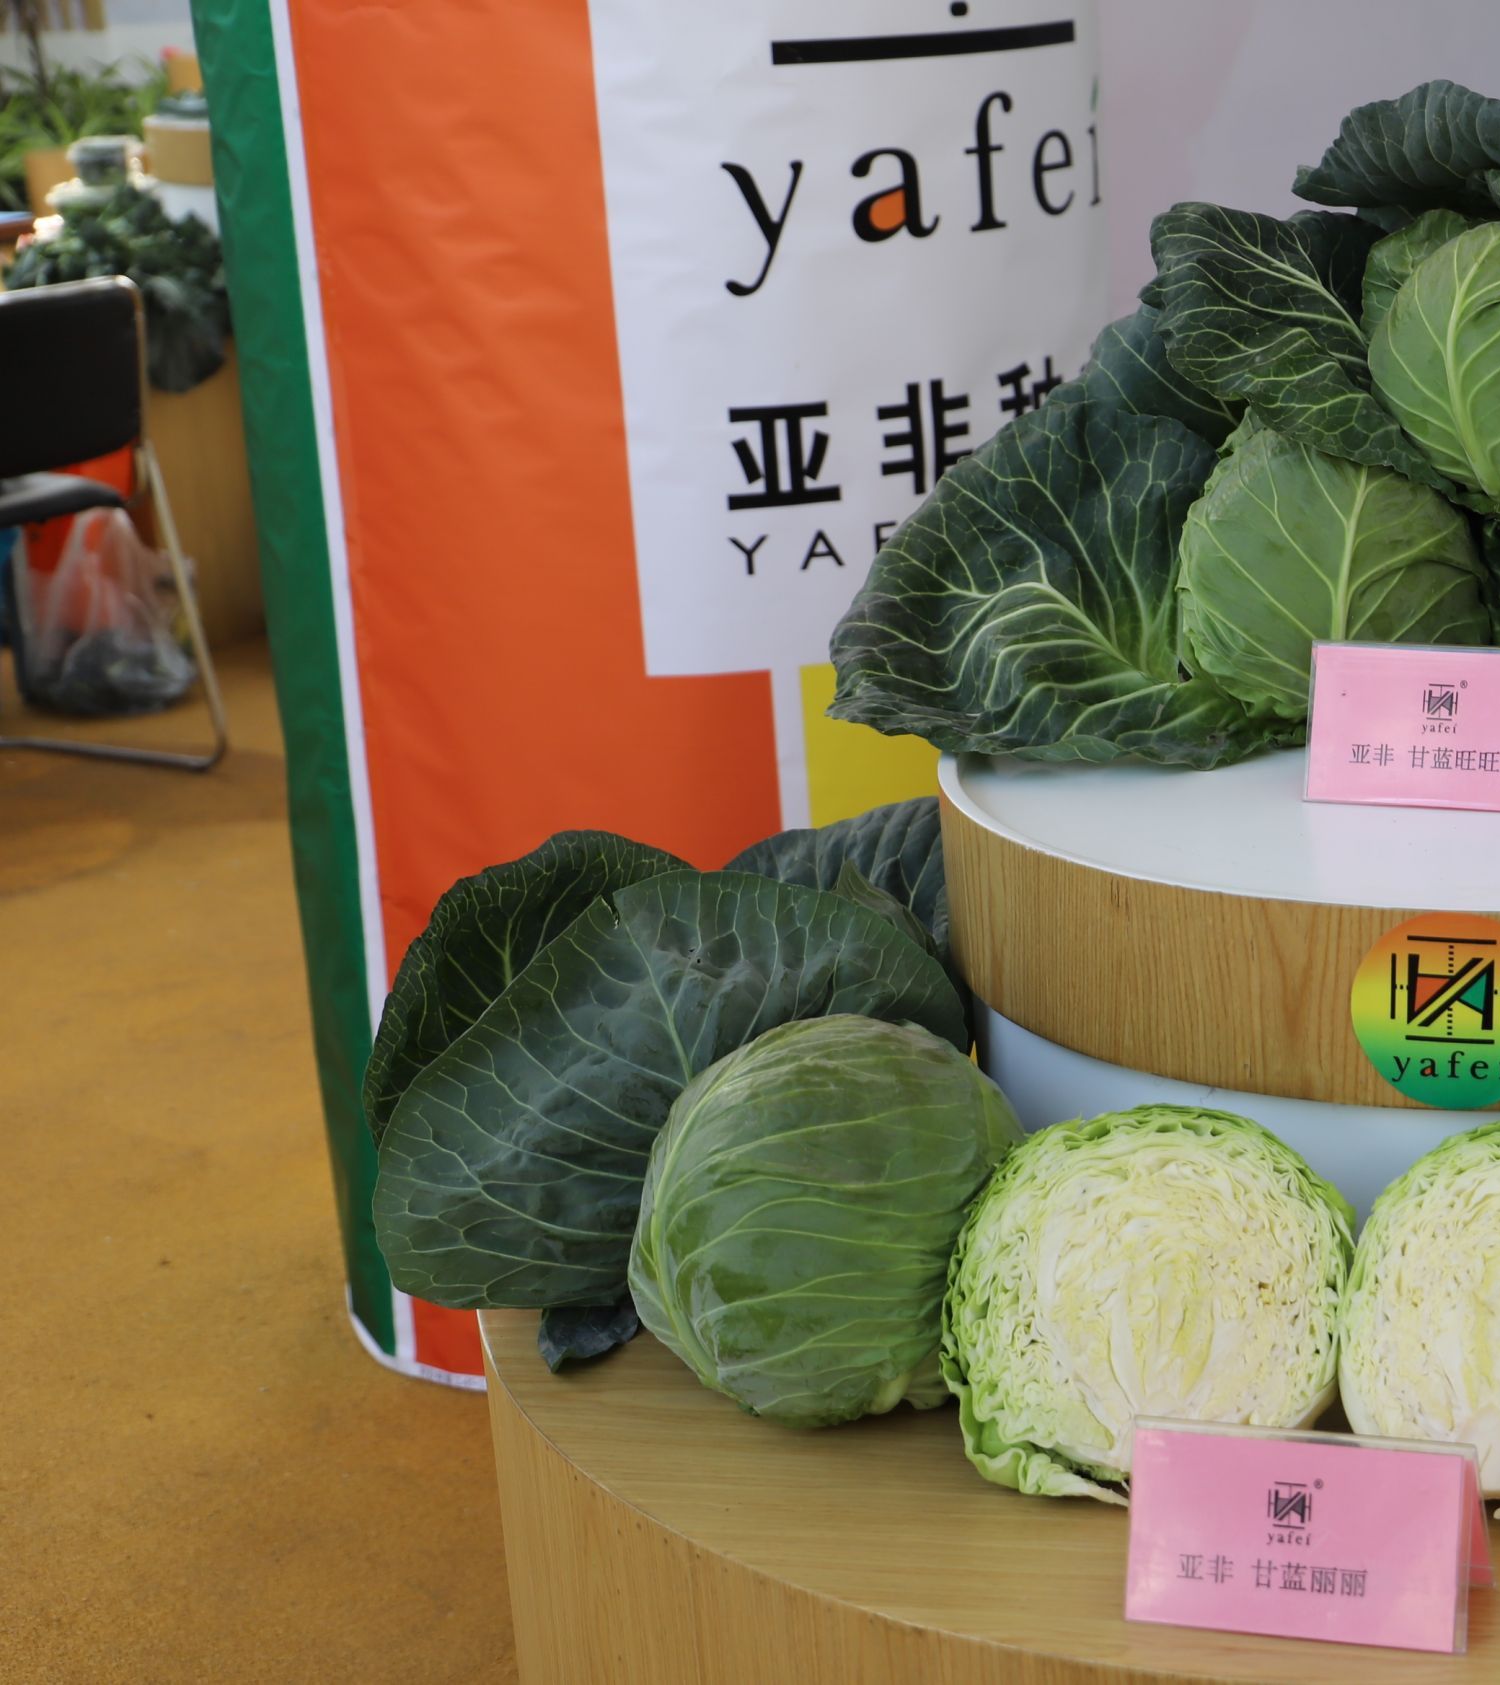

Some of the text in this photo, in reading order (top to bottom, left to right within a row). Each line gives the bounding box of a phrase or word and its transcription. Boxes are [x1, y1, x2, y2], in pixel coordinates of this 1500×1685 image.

[720, 76, 1101, 296] yafei
[1421, 722, 1458, 735] yafei
[1349, 743, 1500, 773] 亚非 甘蓝旺旺
[1266, 1531, 1313, 1547] yafei
[1176, 1553, 1369, 1598] 亚非 甘蓝丽丽
